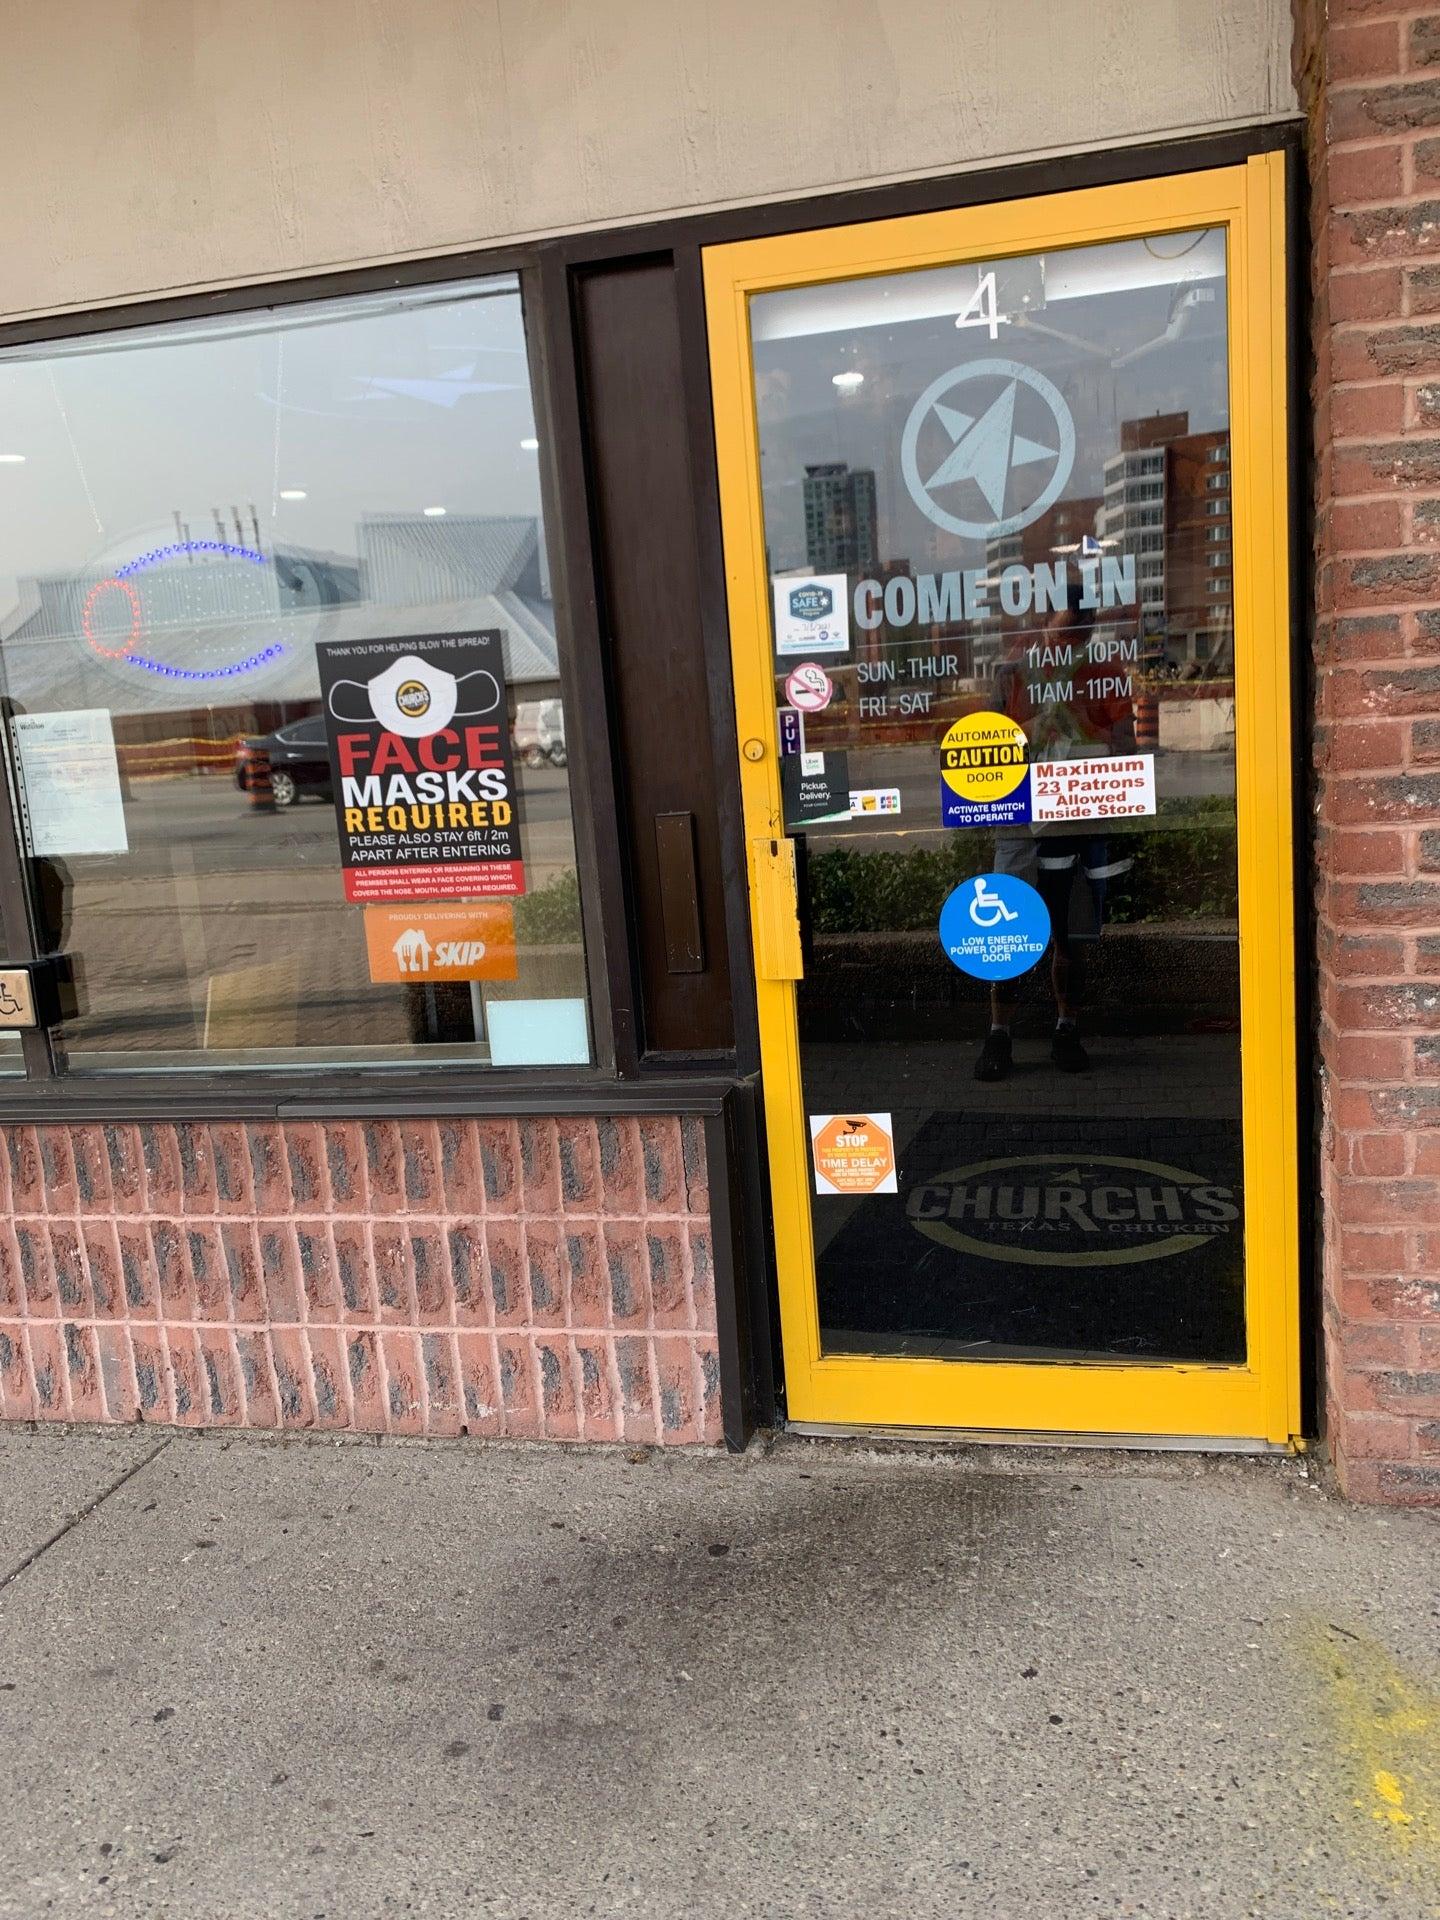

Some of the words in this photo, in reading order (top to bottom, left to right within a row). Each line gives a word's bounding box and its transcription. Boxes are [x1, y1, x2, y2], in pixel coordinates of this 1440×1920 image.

[955, 271, 1012, 340] 4
[854, 568, 991, 630] COME
[1000, 561, 1068, 616] ON
[1078, 554, 1136, 610] IN
[792, 597, 819, 608] SAFE
[326, 647, 351, 656] THANK
[352, 646, 368, 655] YOU
[369, 645, 384, 654] FOR
[386, 642, 418, 652] HELPING
[418, 640, 440, 650] SLOW
[441, 639, 456, 648] THE
[457, 636, 490, 647] SPREAD!
[1026, 643, 1072, 669] 11AM
[1086, 639, 1138, 664] 10PM
[857, 660, 895, 683] SUN
[907, 655, 958, 679] THUR
[1027, 681, 1073, 705] 11AM
[1086, 676, 1132, 700] 11PM
[859, 696, 888, 718] FRI
[899, 692, 933, 715] SAT
[785, 715, 796, 754] PUL
[947, 728, 1020, 743] AUTOMATIC
[337, 725, 505, 778] FACE
[946, 744, 1025, 767] CAUTION
[966, 771, 1004, 784] DOOR
[1036, 759, 1145, 779] Maximum
[341, 768, 508, 808] MASKS
[1037, 781, 1061, 796] 23
[1068, 776, 1145, 792] Patrons
[800, 791, 831, 801] Delivery.
[1056, 790, 1127, 806] Allowed
[345, 800, 512, 833] REQUIRED
[948, 804, 989, 815] ACTIVATE
[990, 802, 1025, 812] SWITCH
[959, 814, 973, 823] TO
[973, 812, 1014, 822] OPERATE
[1038, 804, 1092, 820] Inside
[1098, 802, 1146, 815] Store
[349, 834, 396, 847] PLEASE
[399, 832, 431, 845] ALSO
[434, 831, 464, 843] STAY
[467, 830, 481, 841] 6ft
[491, 829, 508, 841] 2m
[351, 849, 392, 862] APART
[395, 847, 439, 860] AFTER
[443, 843, 511, 858] ENTERING
[400, 867, 432, 875] ENTERING
[444, 865, 480, 873] REMAINING
[490, 863, 512, 871] THESE
[355, 879, 388, 887] PREMISES
[388, 878, 410, 886] SHALL
[411, 877, 430, 885] WEAR
[437, 876, 454, 884] FACE
[455, 875, 489, 883] COVERING
[490, 873, 513, 882] WHICH
[482, 884, 518, 892] REQUIRED.
[389, 912, 423, 921] PROUDLY
[424, 912, 467, 921] DELIVERING
[468, 911, 488, 919] WITH
[962, 936, 985, 946] LOW
[987, 934, 1029, 945] ENERGY
[433, 941, 486, 967] SKIP
[950, 946, 987, 956] POWER
[989, 943, 1043, 953] OPERATED
[982, 953, 1012, 963] DOOR
[836, 1134, 869, 1147] STOP
[820, 1158, 848, 1169] TIME
[851, 1157, 887, 1168] DELAY
[905, 1185, 1240, 1232] CHURCH'S
[984, 1221, 1072, 1232] TEXAS
[1108, 1223, 1230, 1234] CHICKEN
